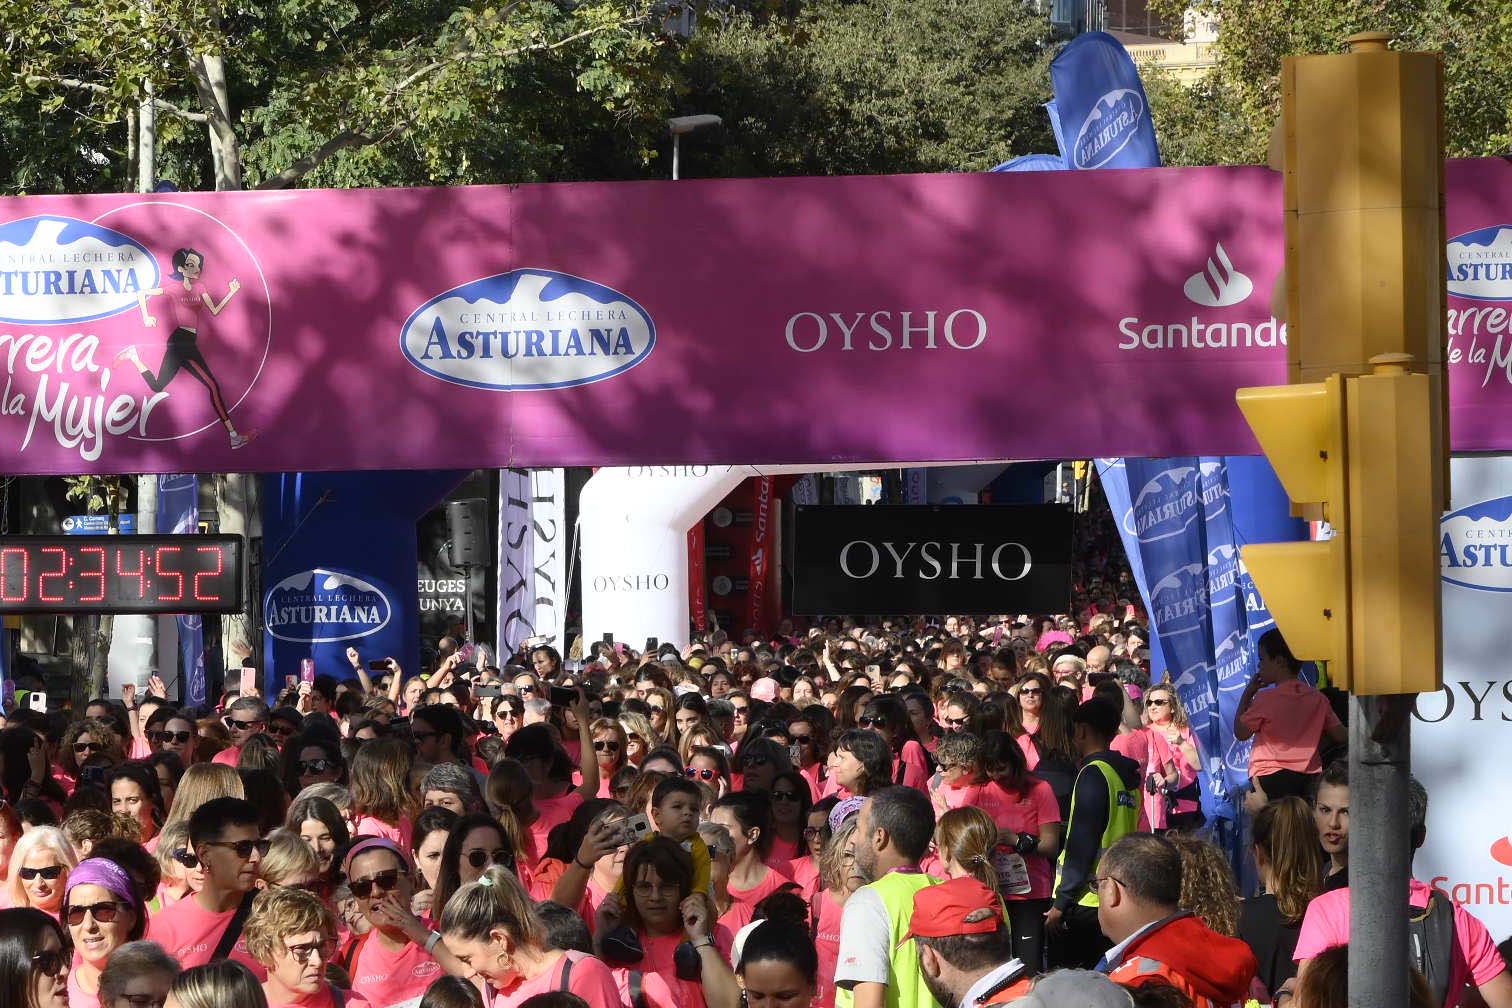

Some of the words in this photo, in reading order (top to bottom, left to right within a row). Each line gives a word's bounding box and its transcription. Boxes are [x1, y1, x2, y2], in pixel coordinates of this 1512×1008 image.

[63, 250, 136, 263] LECHERA
[459, 311, 539, 325] CENTRAL
[545, 309, 629, 322] LECHERA
[785, 308, 988, 354] OYSHO
[1117, 316, 1289, 350] Santande
[420, 315, 636, 361] ASTURIANA
[1468, 335, 1486, 365] la
[1, 375, 26, 417] la
[19, 367, 171, 462] Mujer
[755, 479, 769, 543] Santa
[0, 547, 222, 601] 02:34:52
[504, 467, 537, 652] OYSH
[531, 468, 557, 646] OYSH
[839, 540, 1033, 582] OYSHO
[418, 579, 466, 593] EUGES
[593, 574, 670, 593] OYSHO
[268, 600, 382, 628] ASTURIANA
[419, 598, 465, 611] UNYA
